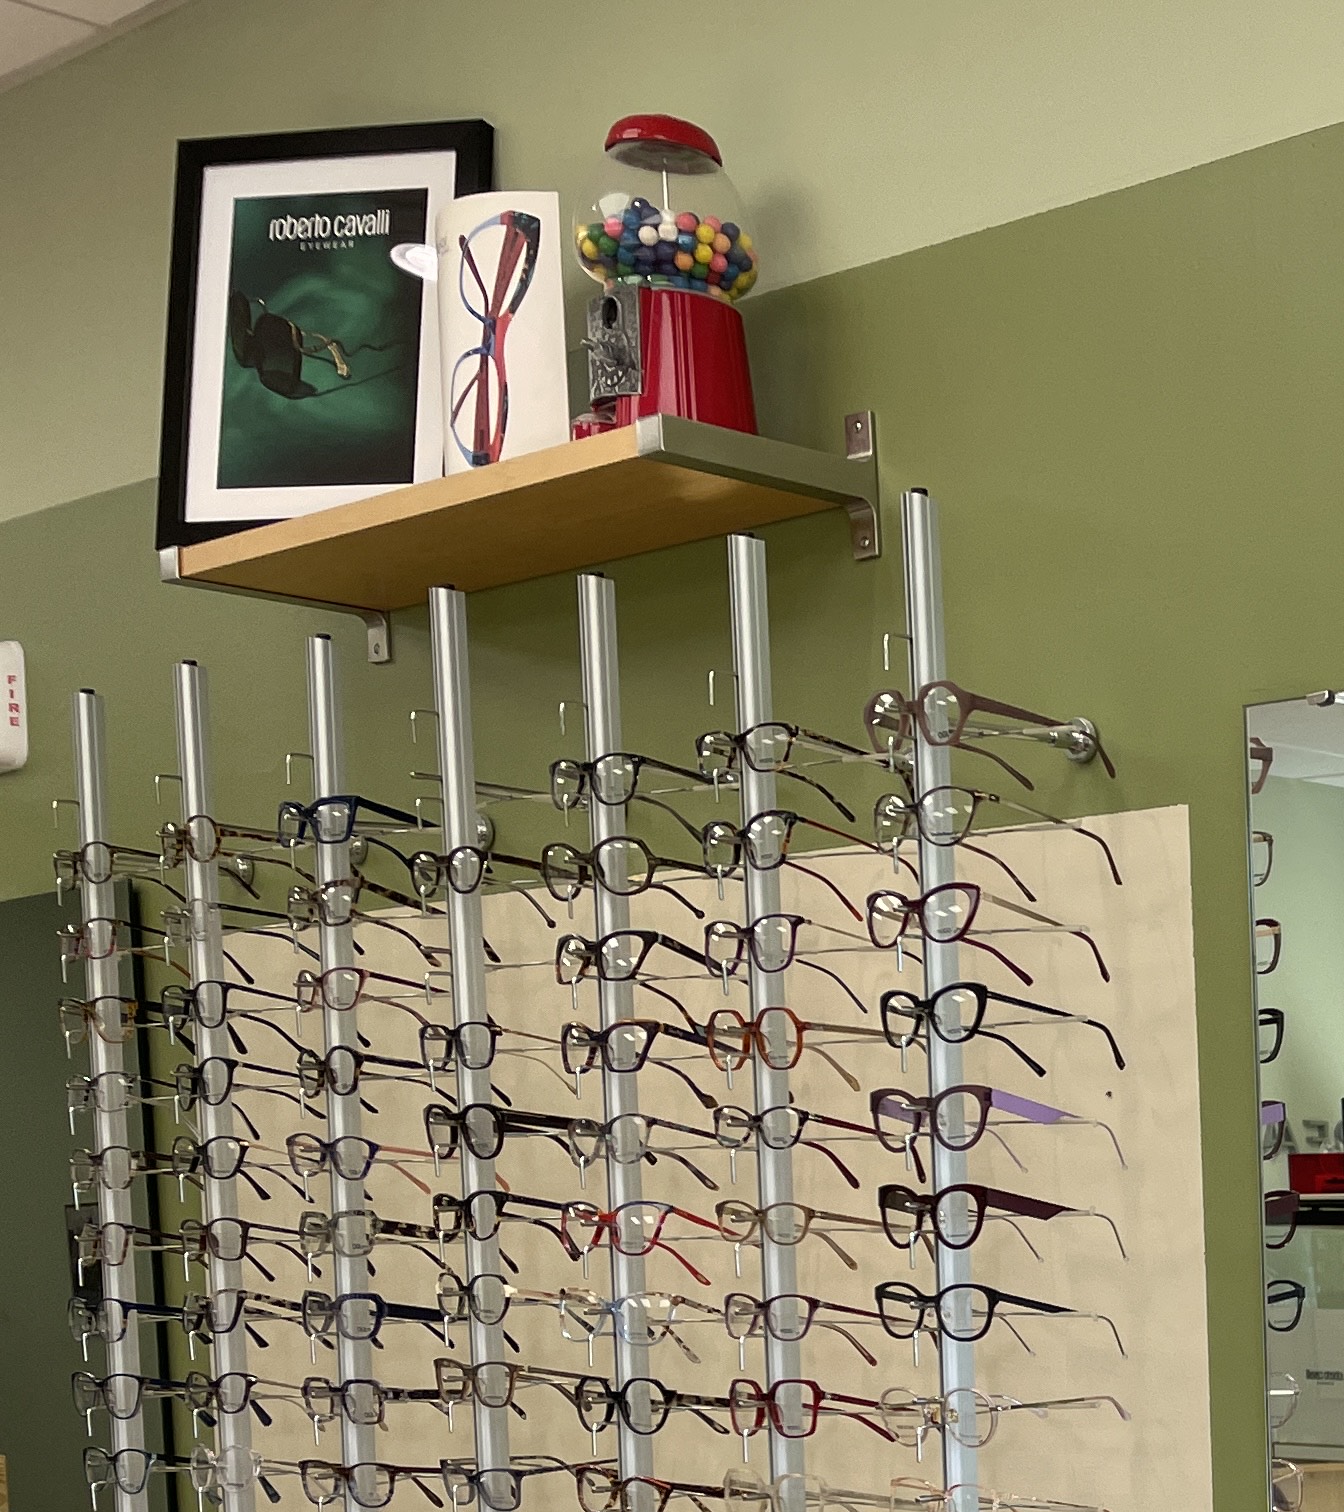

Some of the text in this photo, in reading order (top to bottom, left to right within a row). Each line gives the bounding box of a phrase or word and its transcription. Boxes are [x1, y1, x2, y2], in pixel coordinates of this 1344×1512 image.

[269, 209, 391, 242] roberto cavalli
[300, 239, 355, 251] EYEWEAR
[7, 674, 20, 727] FIRE
